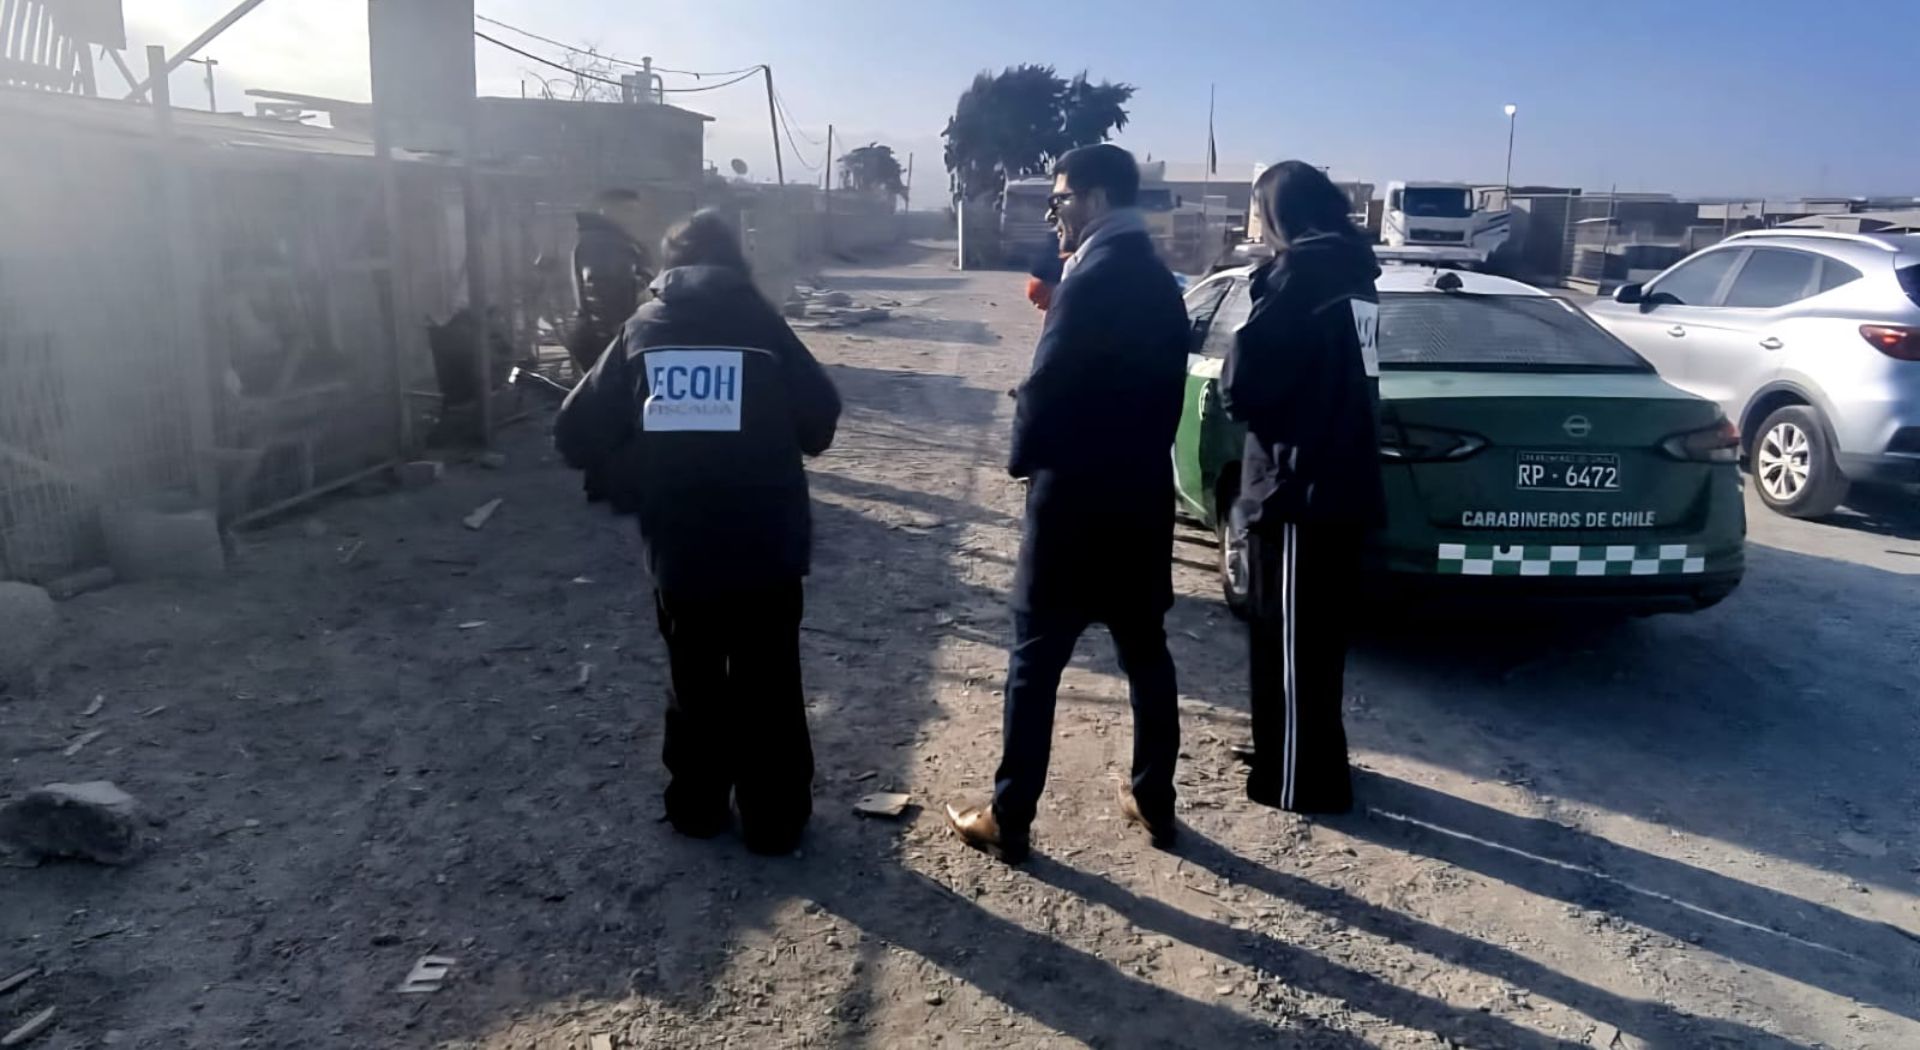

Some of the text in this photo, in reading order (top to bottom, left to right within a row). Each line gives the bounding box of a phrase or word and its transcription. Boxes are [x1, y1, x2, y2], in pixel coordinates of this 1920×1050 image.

[653, 365, 735, 401] ECOH
[1565, 465, 1619, 488] 6472
[1462, 511, 1656, 528] CARABINEROS DE CHILE
